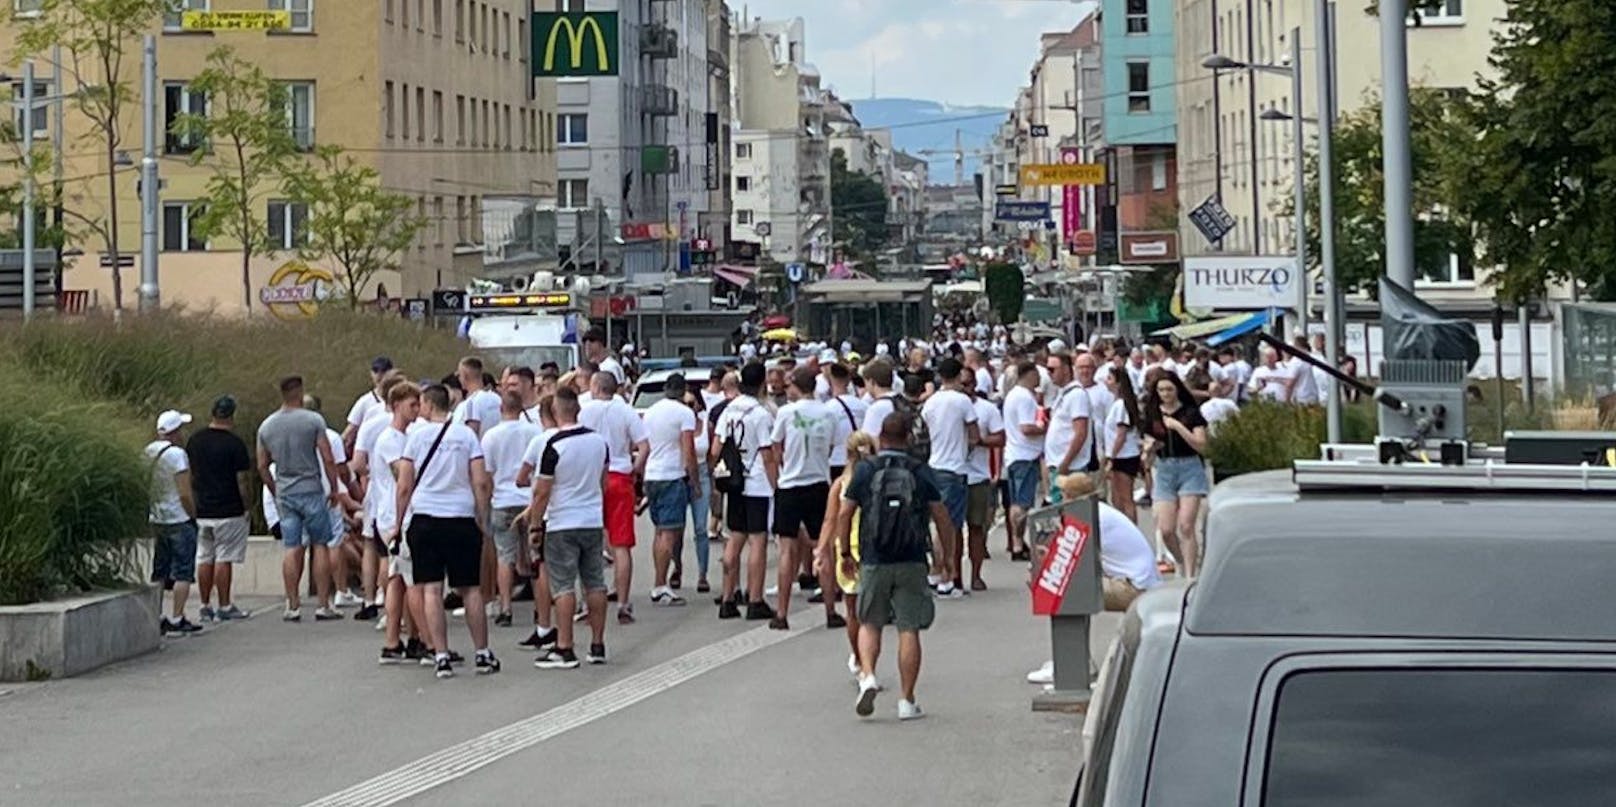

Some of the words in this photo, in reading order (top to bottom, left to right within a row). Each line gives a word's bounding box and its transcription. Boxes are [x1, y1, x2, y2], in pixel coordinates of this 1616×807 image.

[1043, 167, 1100, 180] NEUROTH
[1194, 208, 1222, 237] FOTO
[789, 265, 802, 277] U
[1190, 267, 1289, 287] THURZO
[1038, 525, 1081, 595] Heute
